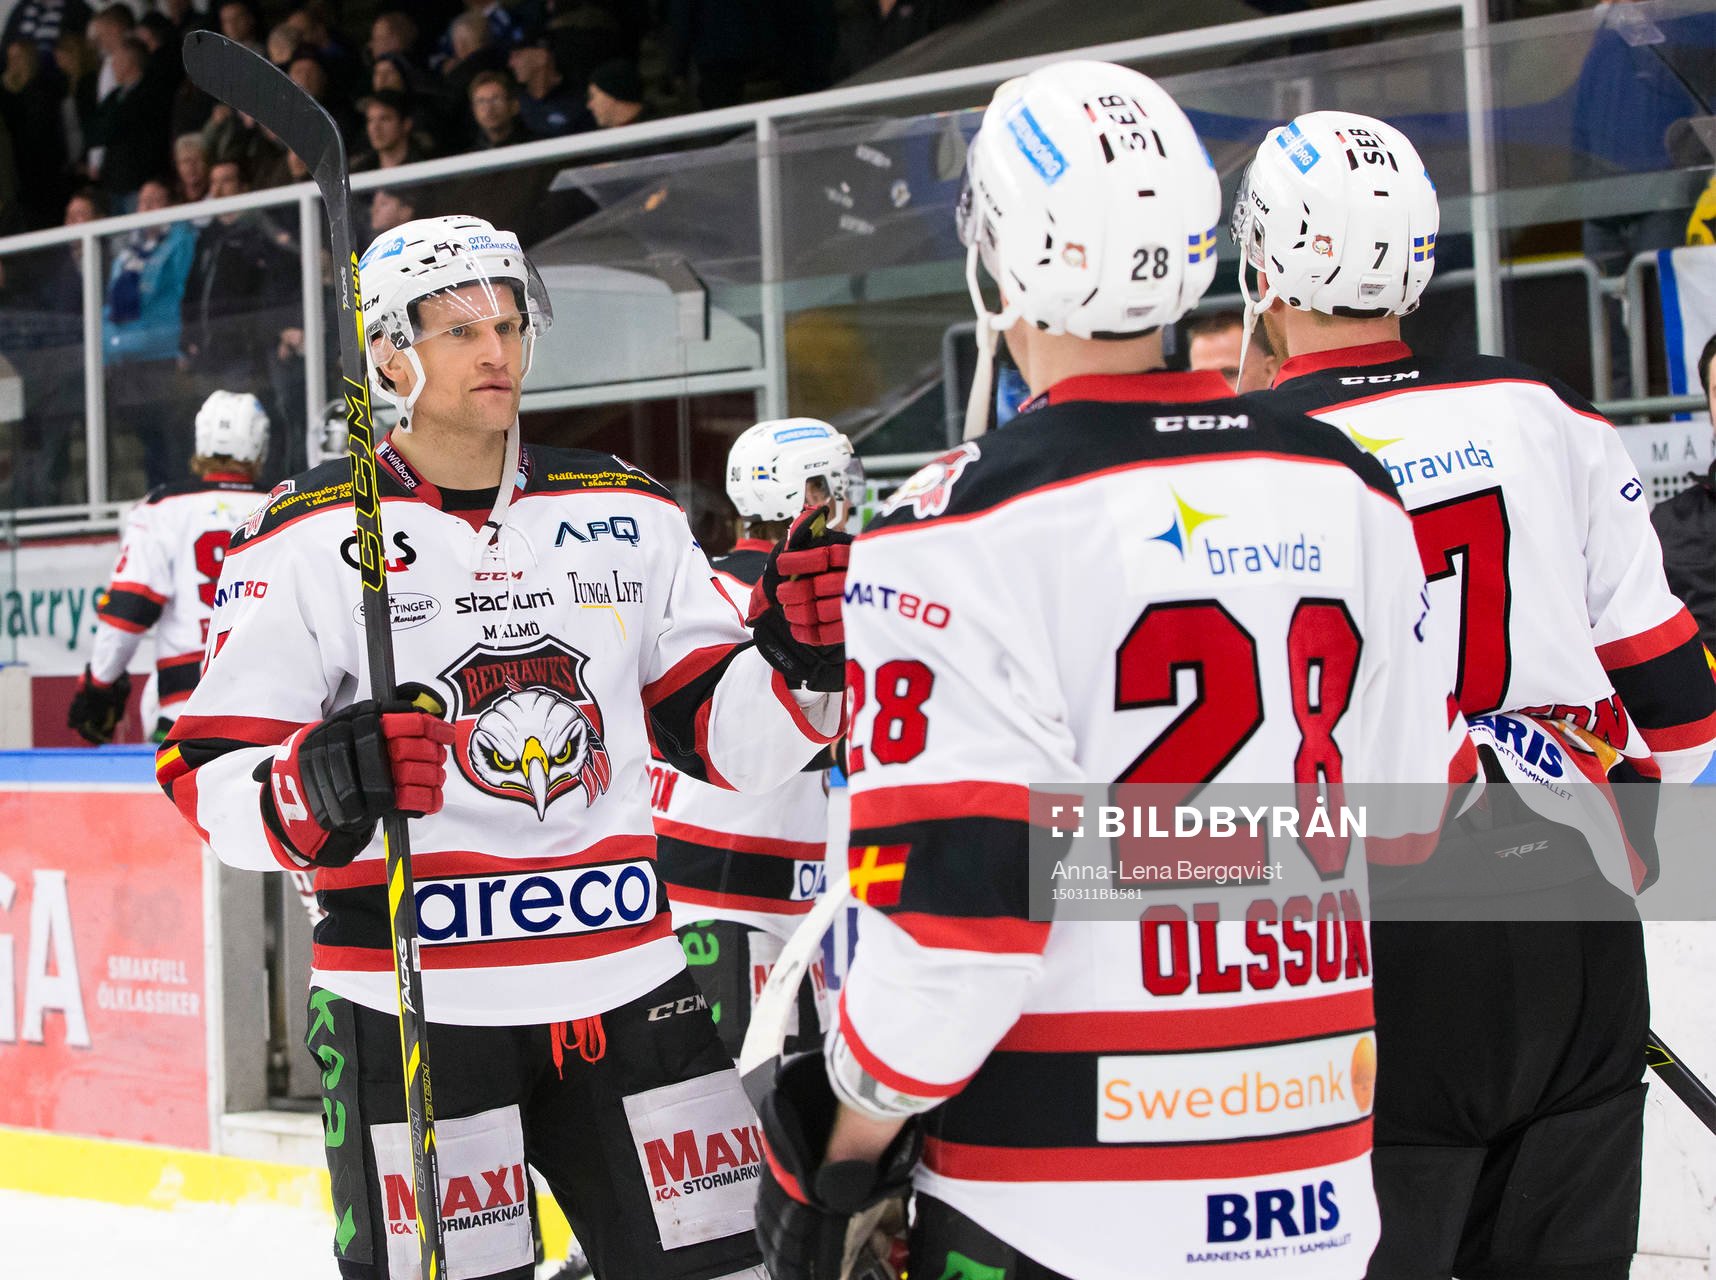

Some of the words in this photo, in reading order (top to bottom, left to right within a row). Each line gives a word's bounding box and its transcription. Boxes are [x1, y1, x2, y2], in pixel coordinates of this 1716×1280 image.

[1098, 94, 1148, 150] SEB
[1348, 128, 1385, 166] SEB
[1251, 190, 1270, 215] CCM
[468, 235, 491, 244] OTTO
[1373, 242, 1389, 270] 7
[1131, 247, 1169, 281] 28
[1339, 370, 1420, 385] CCM
[1153, 415, 1249, 432] CCM
[1383, 440, 1494, 488] bravida
[1653, 435, 1716, 462] MÅ
[344, 376, 384, 592] CCM
[387, 451, 417, 489] Wihlborgs
[270, 481, 354, 515] Ställningsbygg
[1205, 533, 1322, 575] bravida
[475, 571, 524, 581] CCM
[455, 591, 555, 615] stadium
[482, 620, 541, 641] MALMÖ
[462, 655, 576, 709] REDHAWKS
[1108, 597, 1364, 890] 28
[415, 866, 651, 941] areco
[1139, 888, 1370, 996] OLSSON
[397, 935, 418, 1015] TACKS
[647, 993, 709, 1022] CCM
[1103, 1061, 1346, 1122] Swedbank
[643, 1126, 764, 1187] MAXI
[656, 1187, 681, 1202] ICA
[1207, 1180, 1340, 1243] BRIS
[390, 1222, 412, 1235] ICA
[1186, 1250, 1251, 1264] BARNENS
